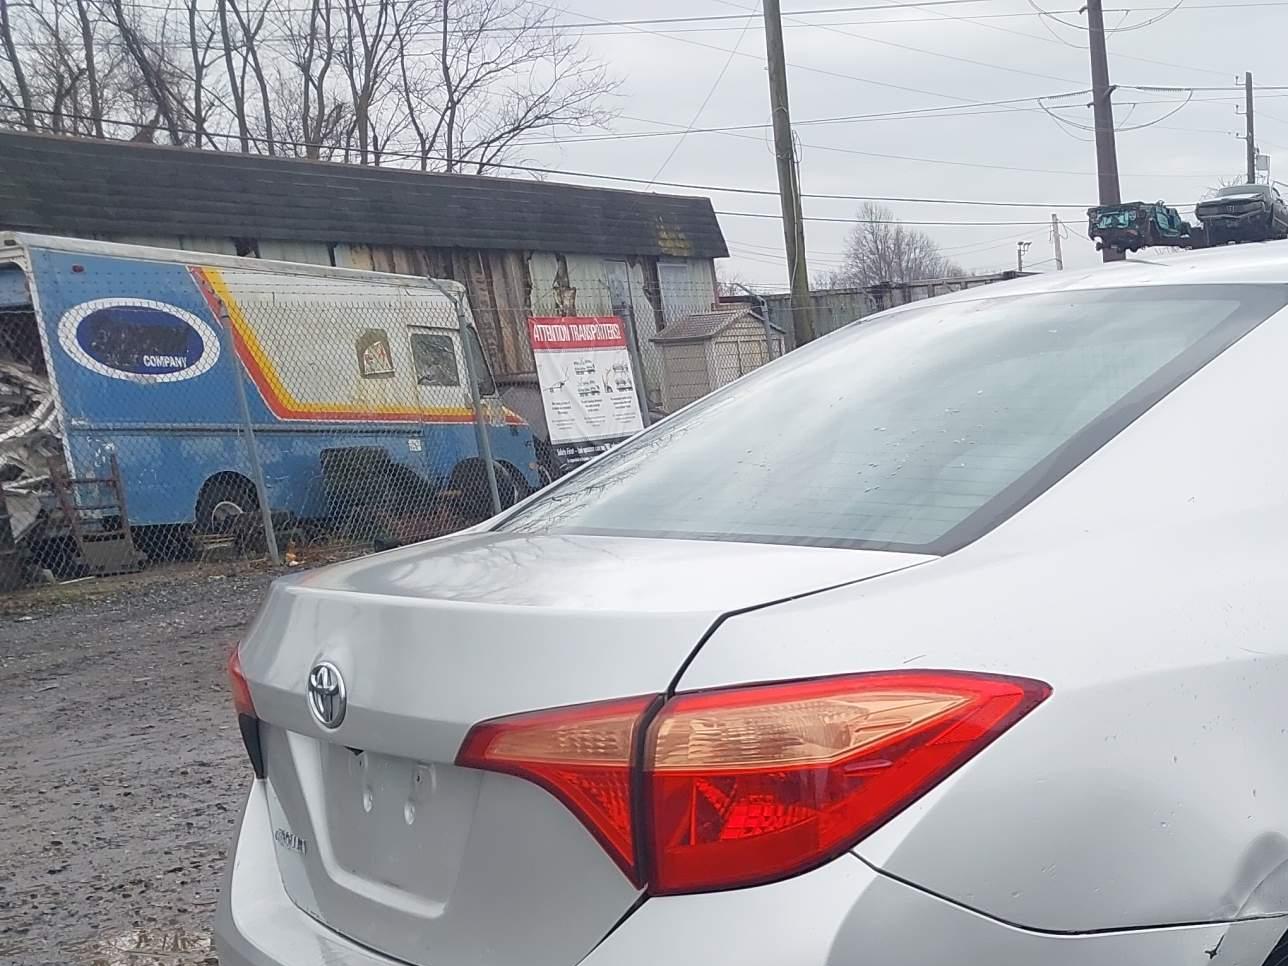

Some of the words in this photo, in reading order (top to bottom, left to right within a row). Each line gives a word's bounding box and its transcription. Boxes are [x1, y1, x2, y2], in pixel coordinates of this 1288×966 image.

[533, 324, 571, 342] ATTENTION
[569, 323, 622, 341] TRANSPORTERS!
[143, 355, 188, 368] COMPANY
